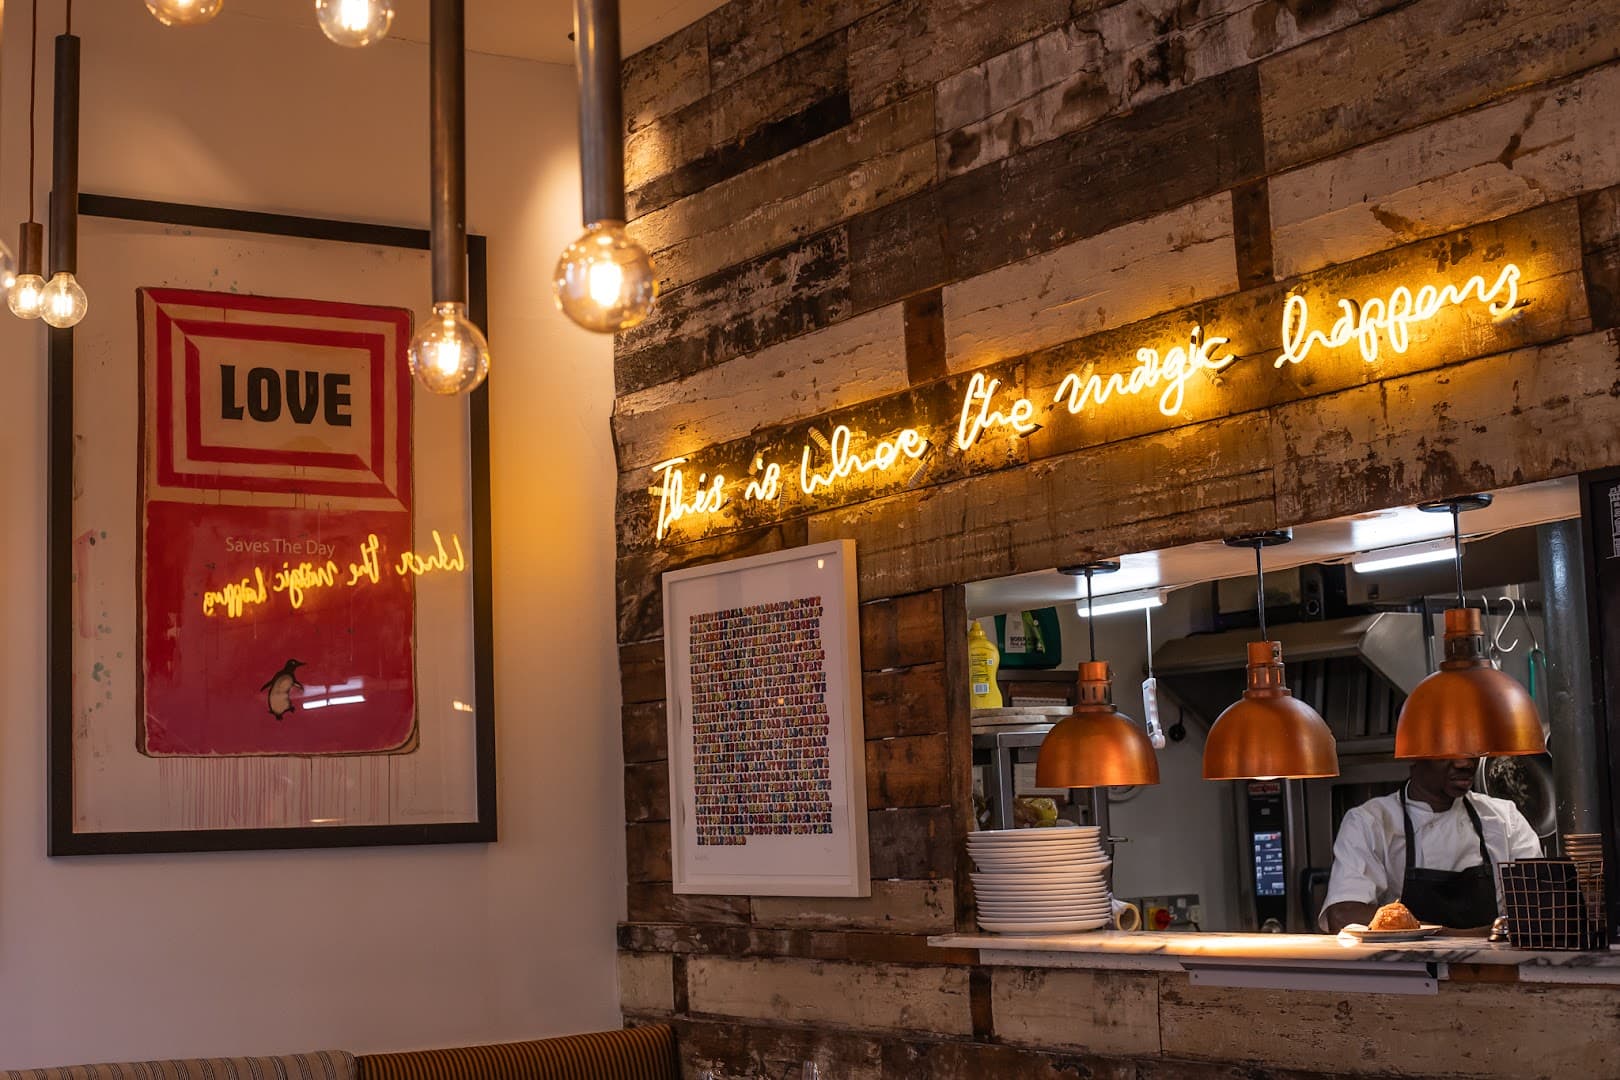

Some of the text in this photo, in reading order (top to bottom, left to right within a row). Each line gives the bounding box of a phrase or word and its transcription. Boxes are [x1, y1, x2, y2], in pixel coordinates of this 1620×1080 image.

[220, 364, 352, 427] LOVE
[652, 457, 725, 541] This
[745, 457, 781, 501] is
[957, 372, 1034, 451] the
[1054, 325, 1236, 416] magic
[1274, 263, 1522, 369] happens
[225, 536, 336, 559] Saves The Day
